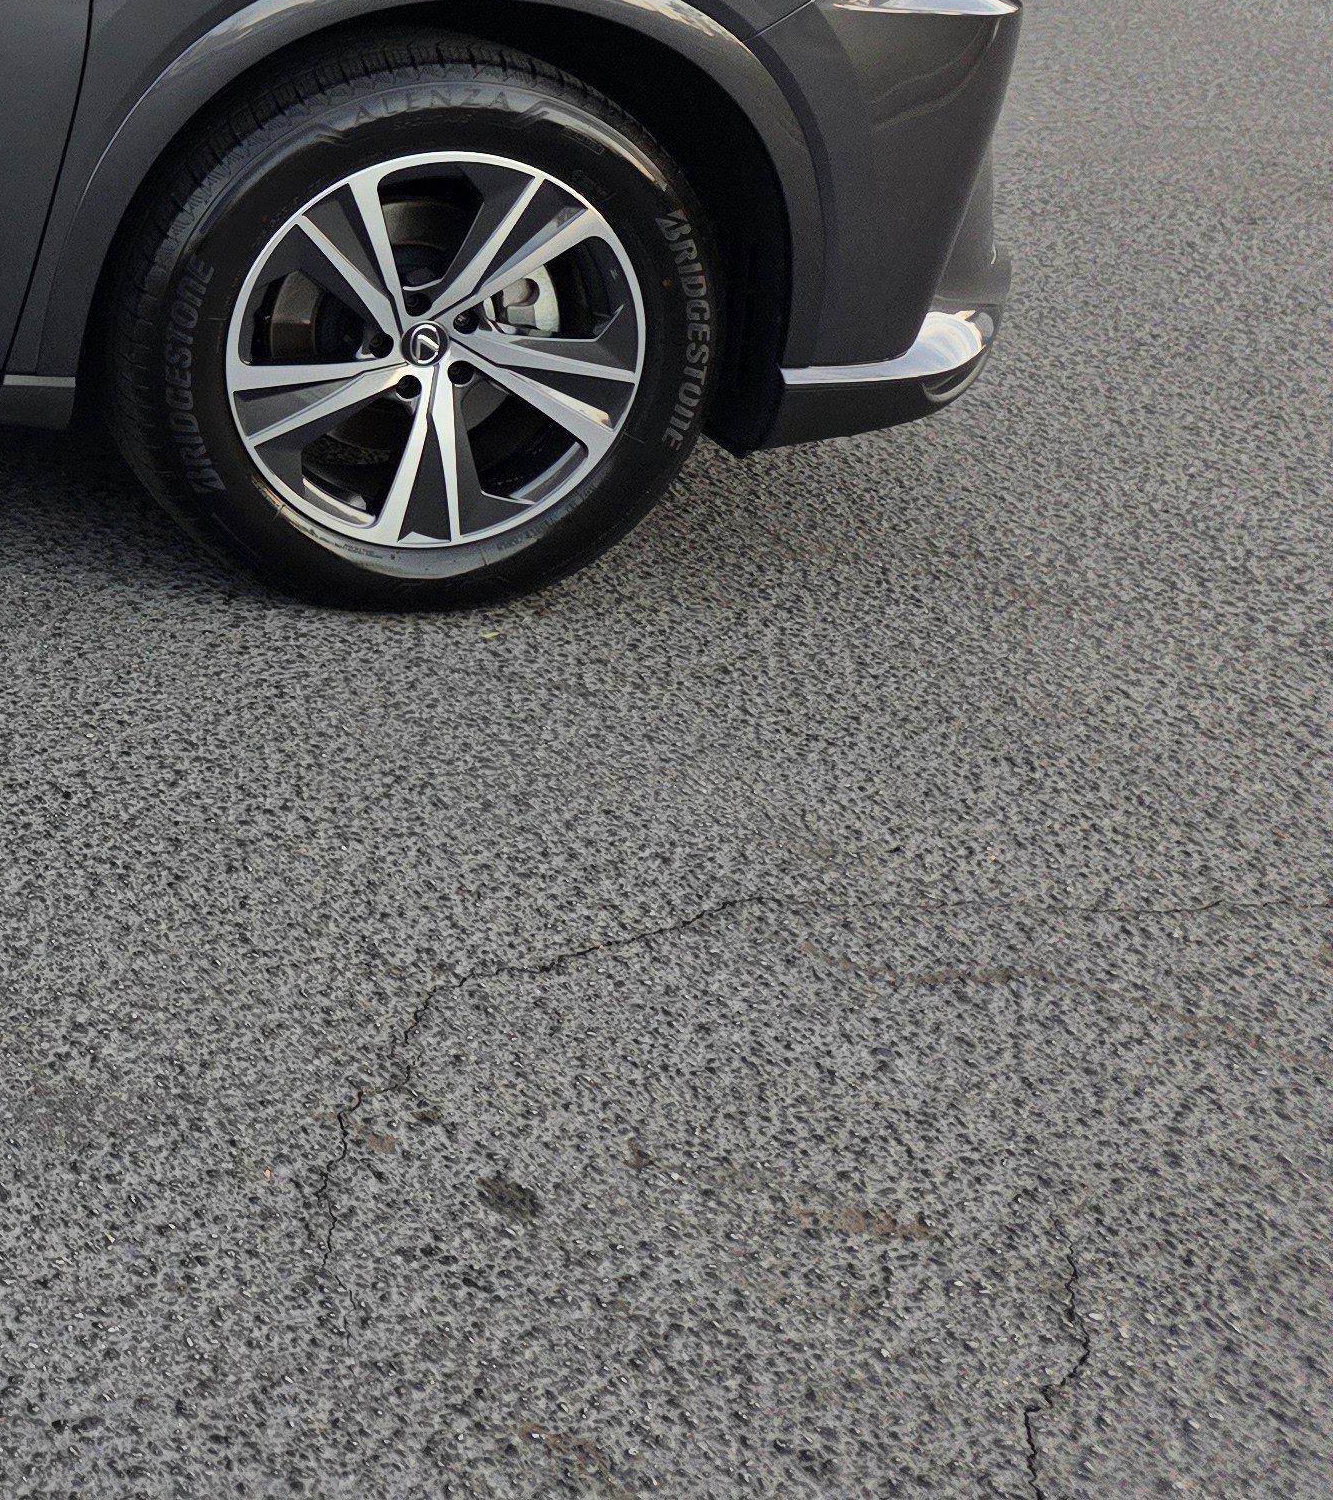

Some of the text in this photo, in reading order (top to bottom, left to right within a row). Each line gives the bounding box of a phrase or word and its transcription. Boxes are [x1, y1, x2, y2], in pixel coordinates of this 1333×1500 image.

[354, 87, 512, 125] ALENZA
[164, 254, 226, 493] BRIDGESTONE
[655, 208, 711, 451] BRIDGESTONE
